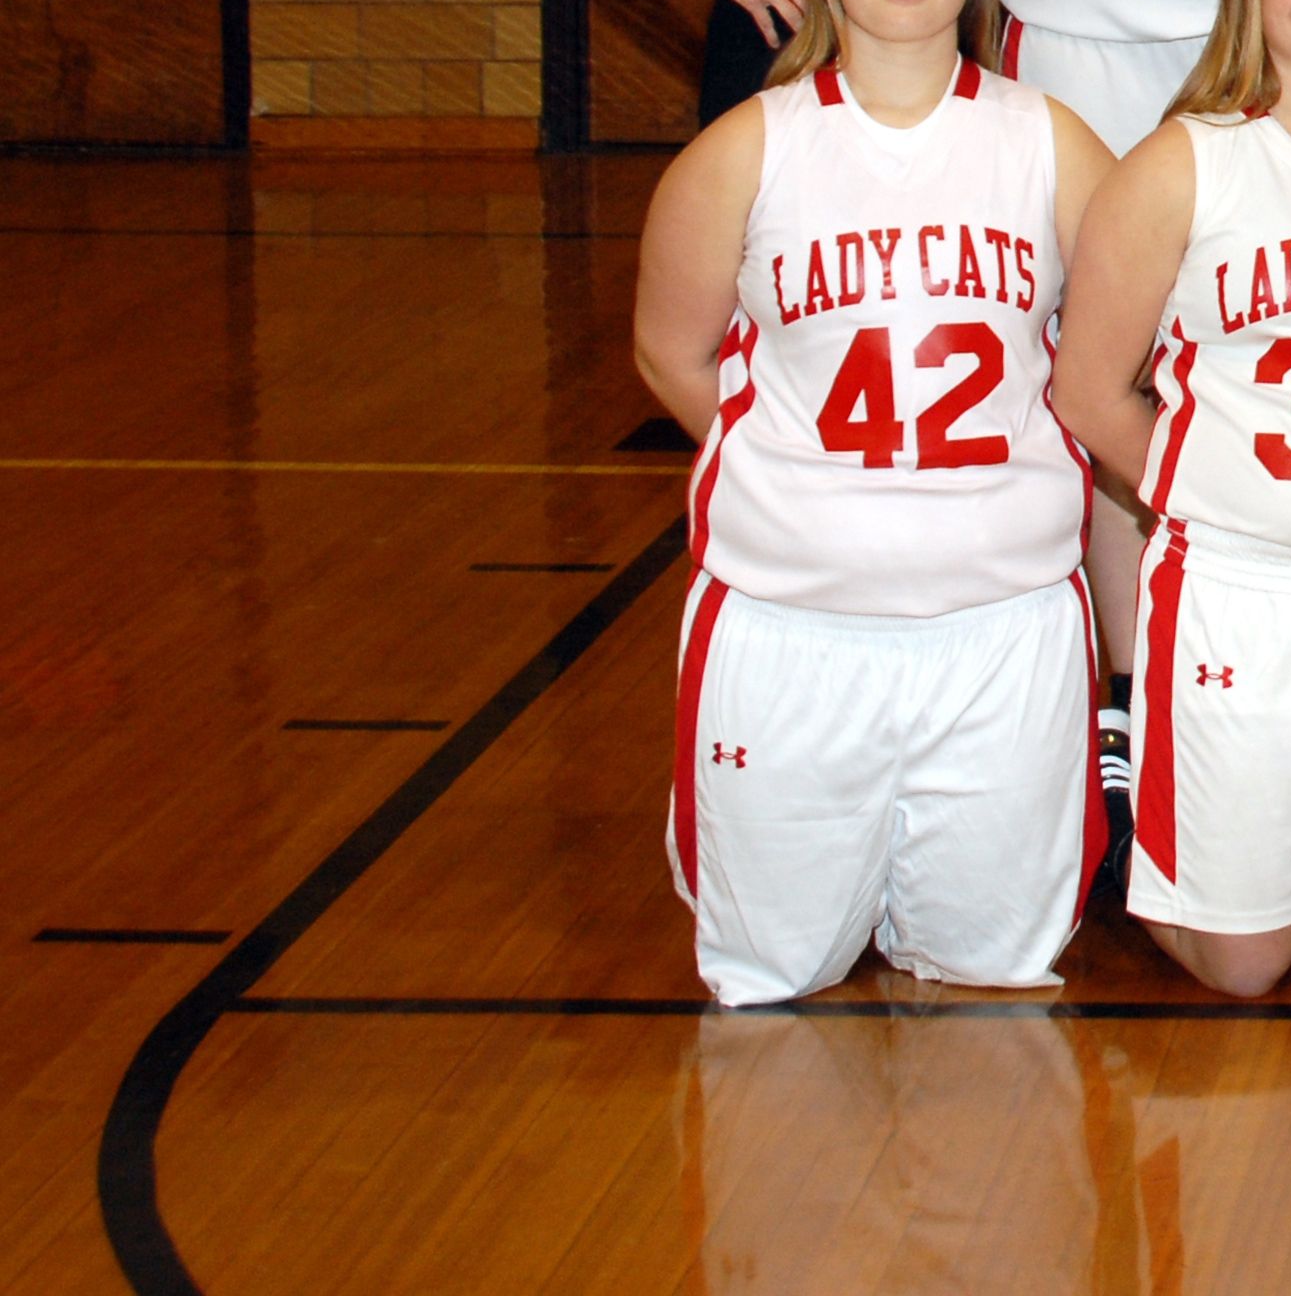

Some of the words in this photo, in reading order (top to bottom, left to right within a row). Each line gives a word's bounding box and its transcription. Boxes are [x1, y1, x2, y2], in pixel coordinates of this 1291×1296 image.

[772, 227, 901, 326] LADY
[918, 224, 1035, 313] CATS
[816, 322, 1009, 470] 42
